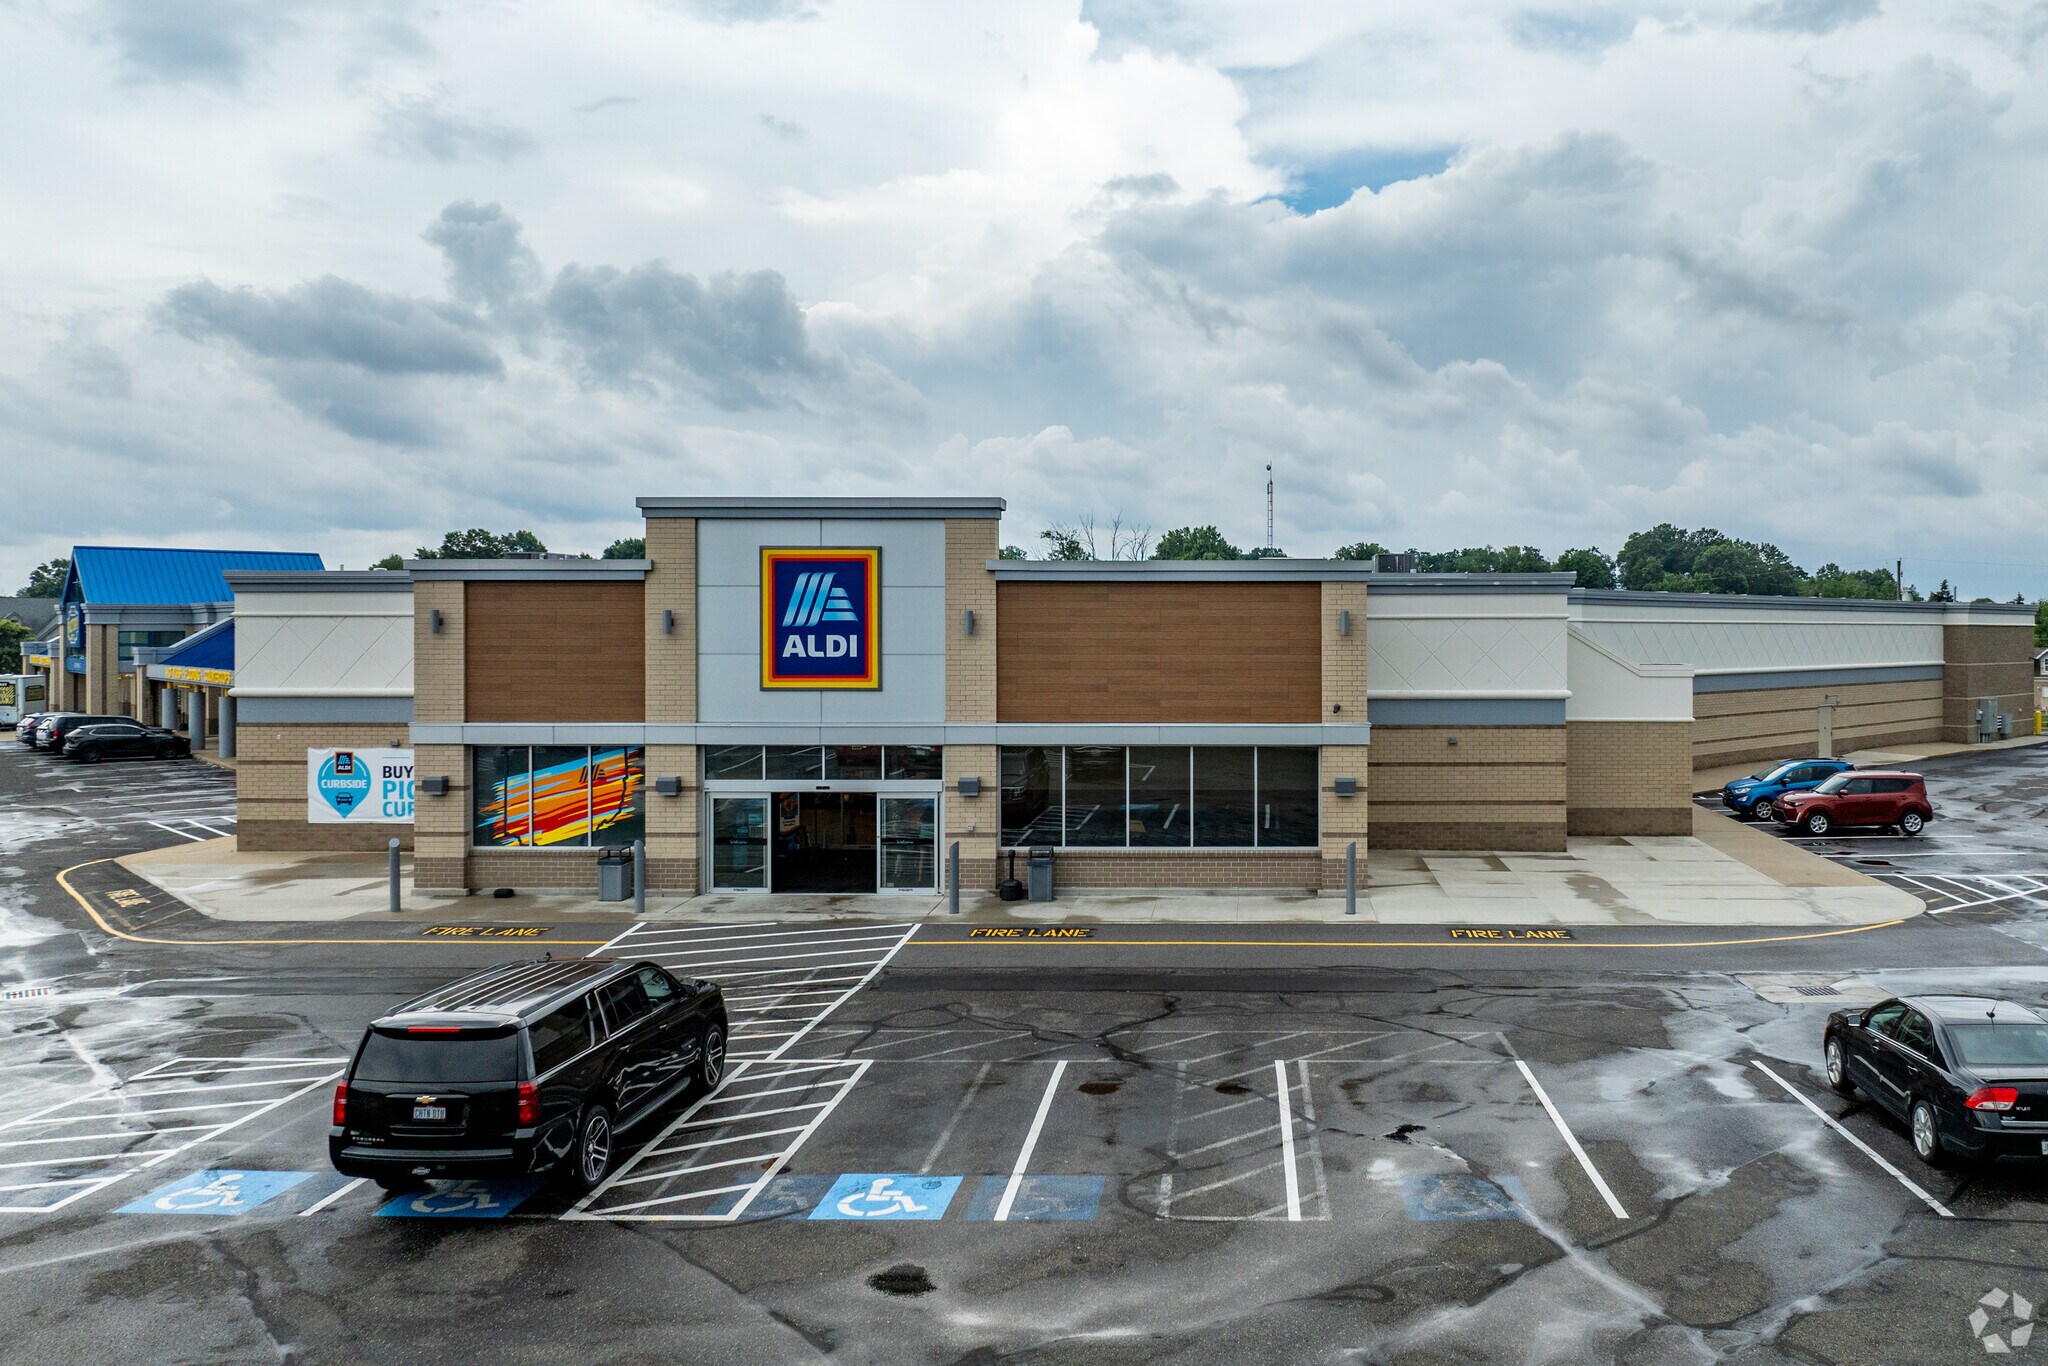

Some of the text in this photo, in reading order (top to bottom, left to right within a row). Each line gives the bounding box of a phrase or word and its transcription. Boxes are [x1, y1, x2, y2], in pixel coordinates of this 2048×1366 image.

[782, 634, 858, 658] ALDI
[383, 765, 414, 778] BUY
[321, 779, 368, 789] CURBSIDE
[422, 926, 549, 937] FIRE LANE
[969, 928, 1090, 938] FIRE LANE
[1450, 929, 1571, 939] FIRE LANE
